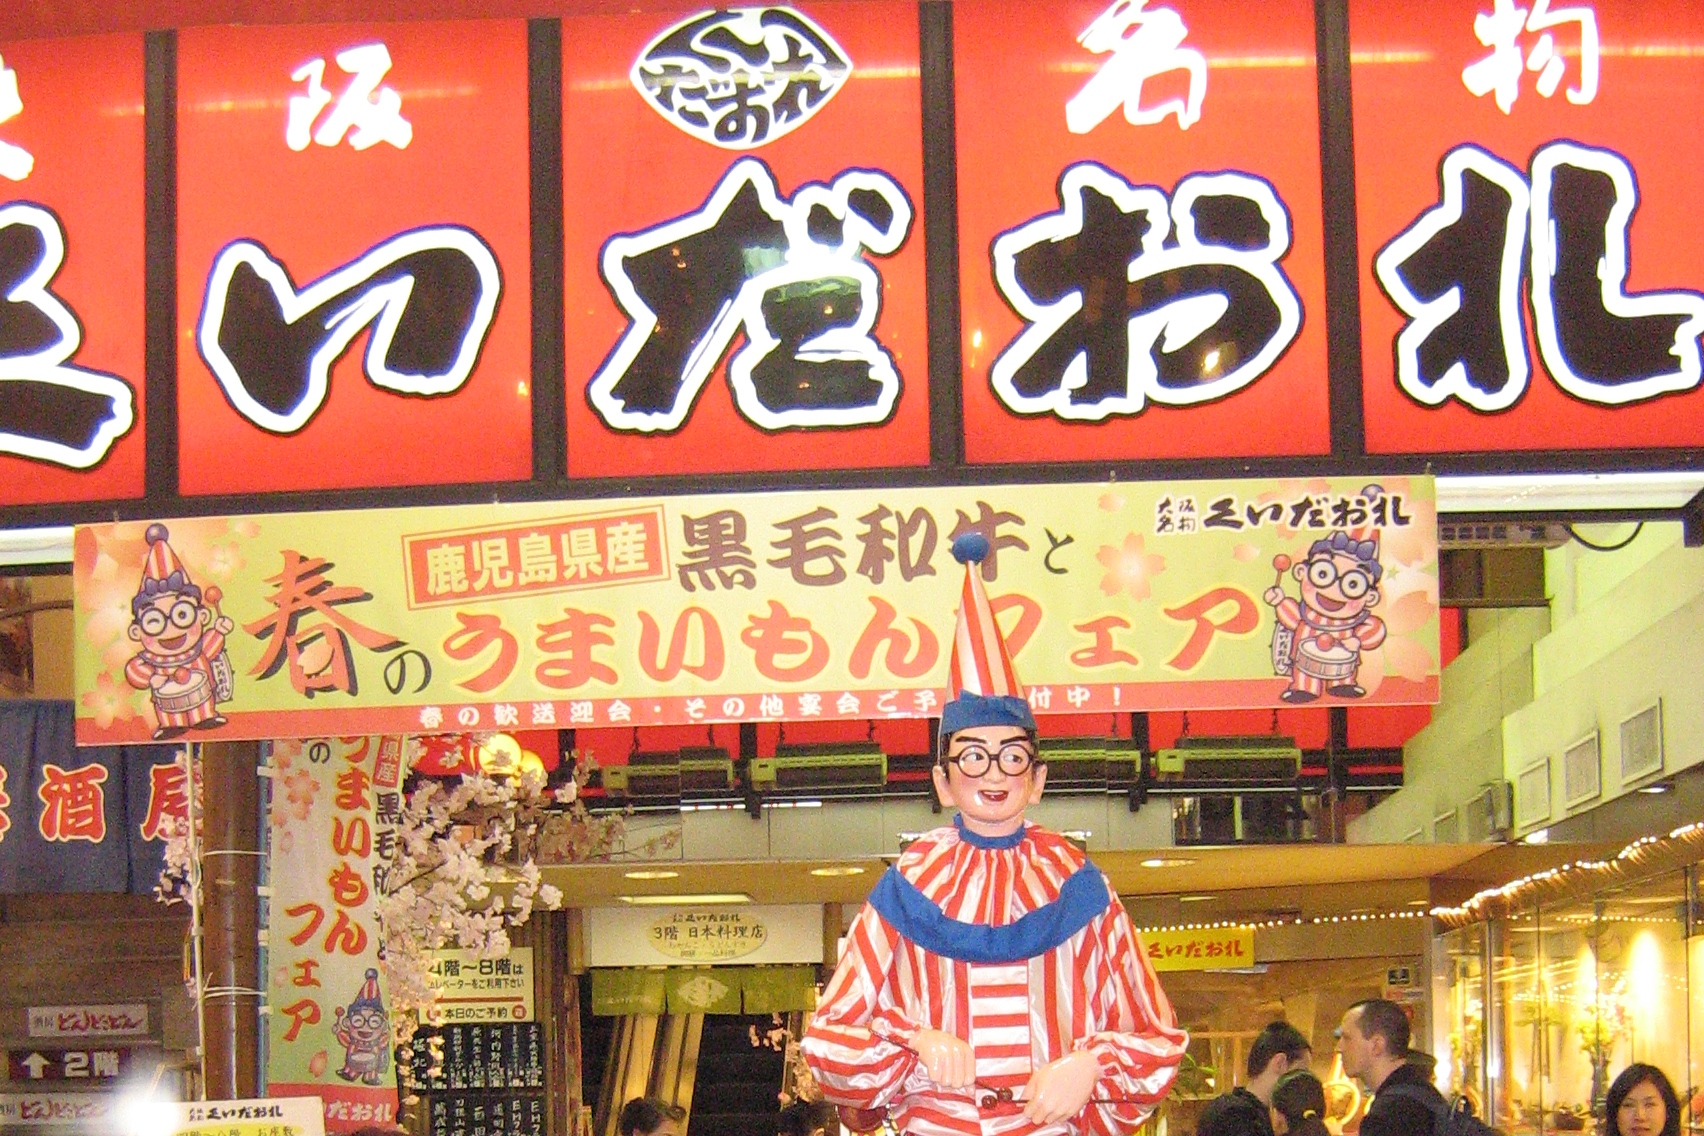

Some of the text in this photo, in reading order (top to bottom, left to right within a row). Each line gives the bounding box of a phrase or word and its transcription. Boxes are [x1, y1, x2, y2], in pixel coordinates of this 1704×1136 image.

[426, 520, 650, 597] 鹿児島県産
[242, 550, 432, 698] 春の
[653, 925, 764, 941] 3階 日本料理店
[281, 903, 325, 1041] フェア
[64, 1052, 119, 1077] 2階
